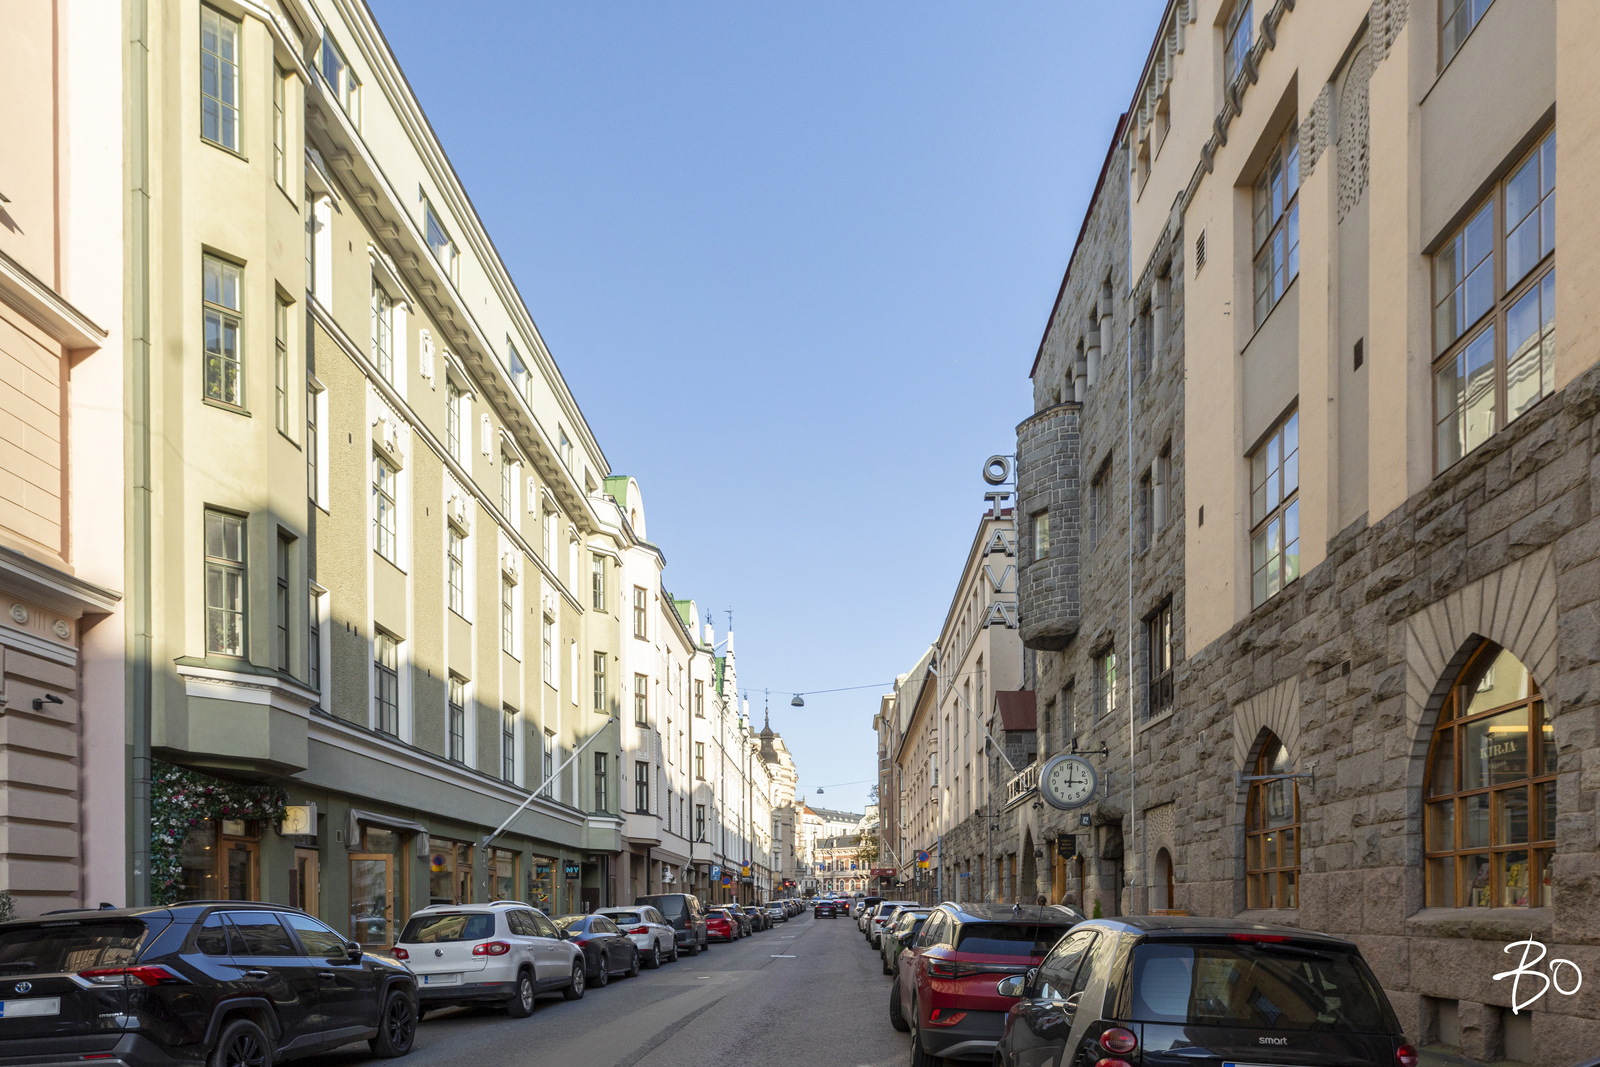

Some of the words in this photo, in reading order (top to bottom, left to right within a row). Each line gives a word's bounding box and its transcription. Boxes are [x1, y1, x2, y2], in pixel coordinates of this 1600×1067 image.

[983, 455, 1015, 629] OTAVA
[1082, 816, 1089, 824] 12
[713, 866, 719, 875] P
[1258, 1036, 1288, 1046] smart
